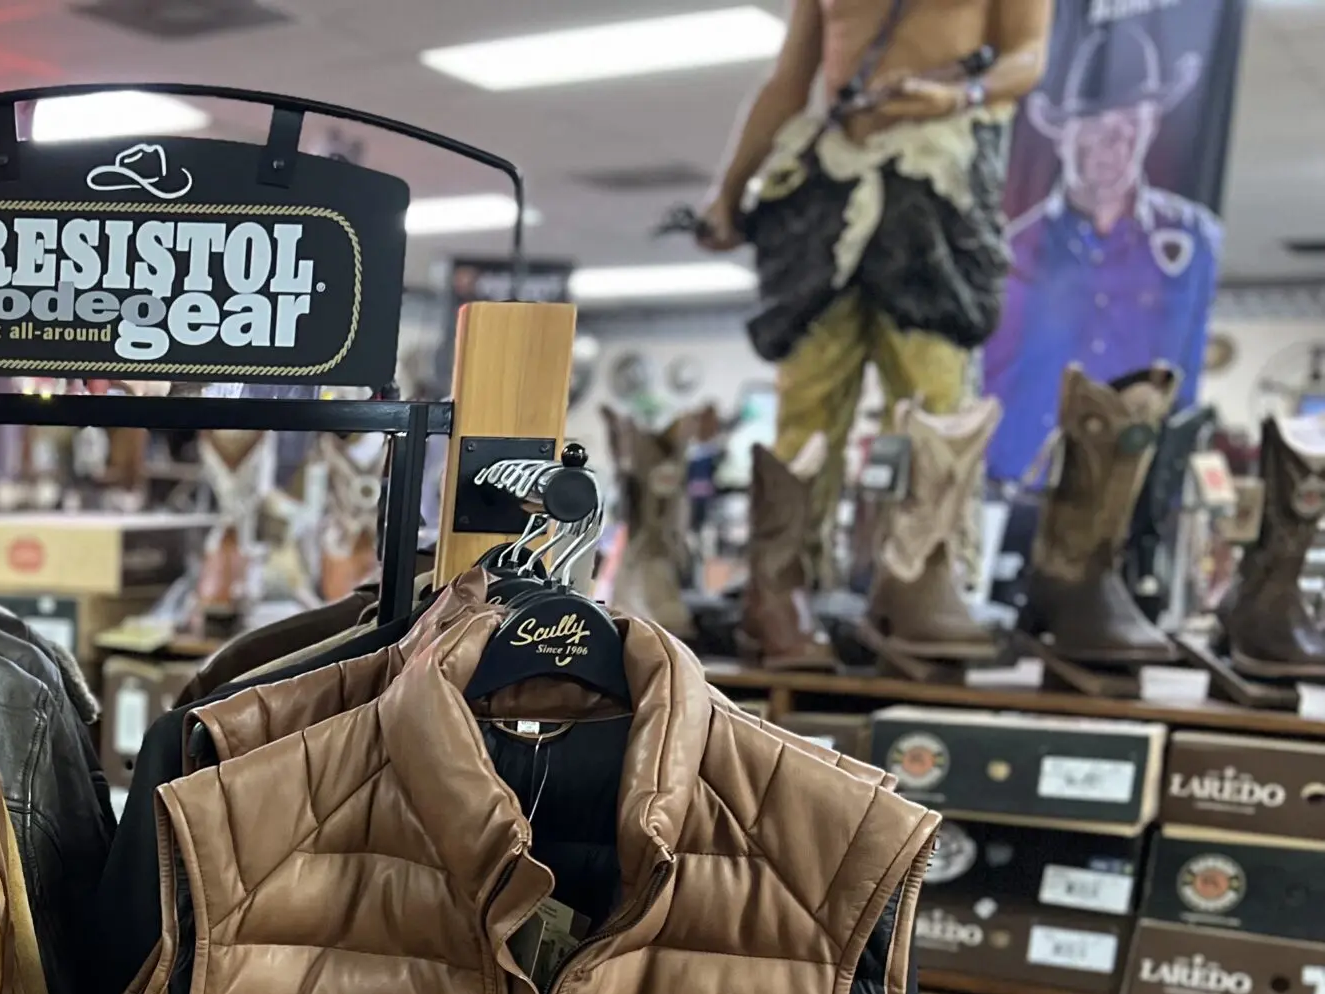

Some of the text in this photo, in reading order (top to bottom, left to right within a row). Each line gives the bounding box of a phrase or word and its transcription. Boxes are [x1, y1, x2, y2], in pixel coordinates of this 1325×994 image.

[9, 322, 111, 342] all-around
[510, 613, 591, 666] Scully
[536, 644, 588, 656] Since 1906
[1169, 772, 1286, 808] LAREDO
